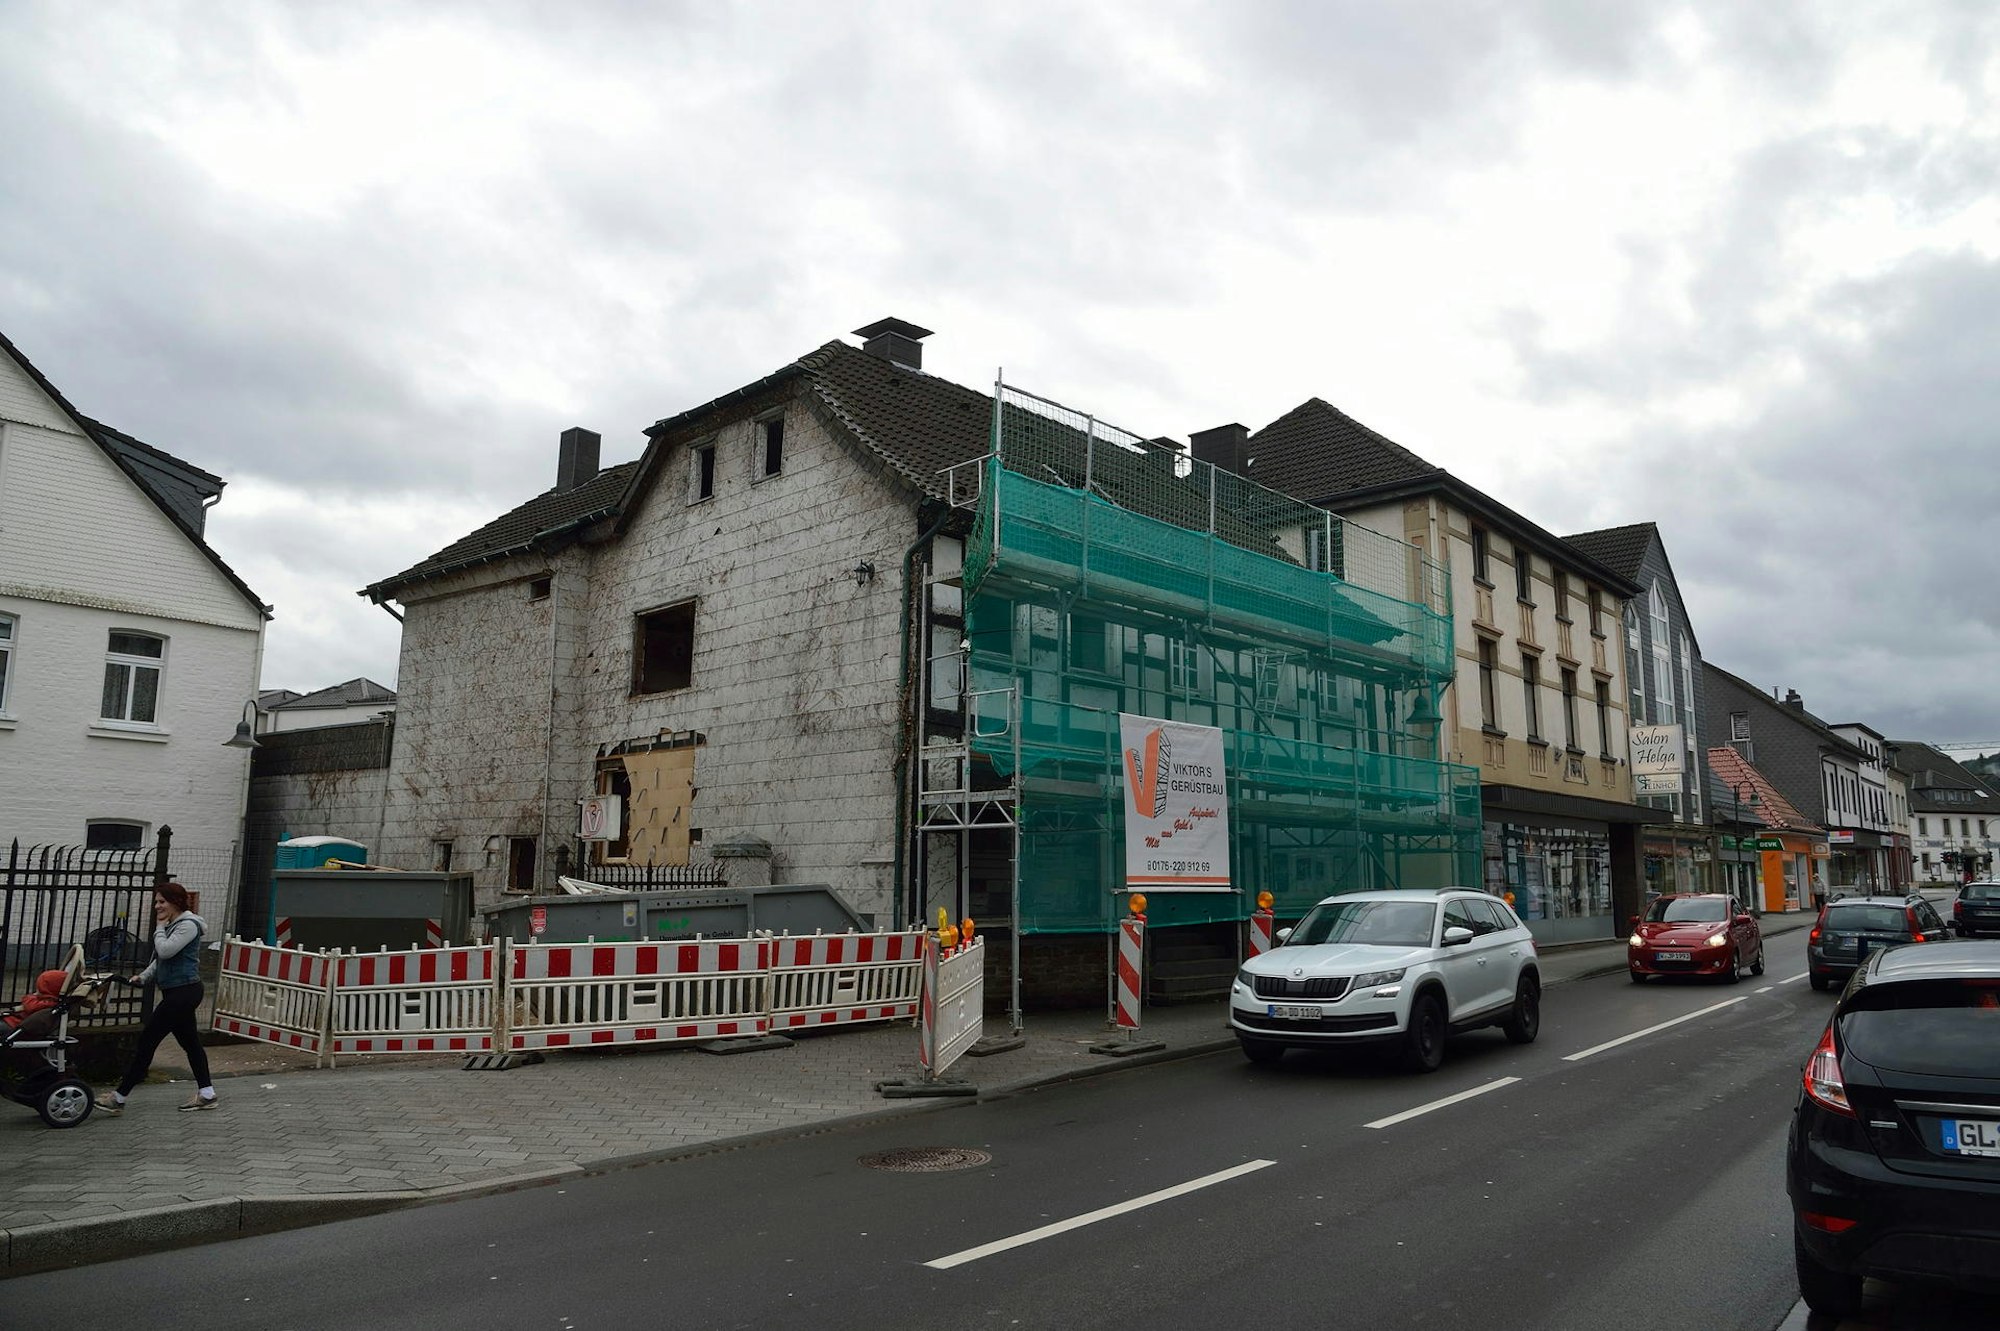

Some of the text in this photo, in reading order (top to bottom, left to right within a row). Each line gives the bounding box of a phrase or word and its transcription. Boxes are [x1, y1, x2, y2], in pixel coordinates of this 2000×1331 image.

[1632, 728, 1669, 746] Salon
[1637, 746, 1675, 771] Helga
[1173, 763, 1212, 778] VIKTOR'S
[1171, 779, 1224, 795] GERÜSTBAU
[1145, 836, 1160, 848] Mit
[1152, 861, 1210, 872] 0176-220 912 69
[711, 930, 734, 938] GmbH
[1959, 1123, 1996, 1148] GL
